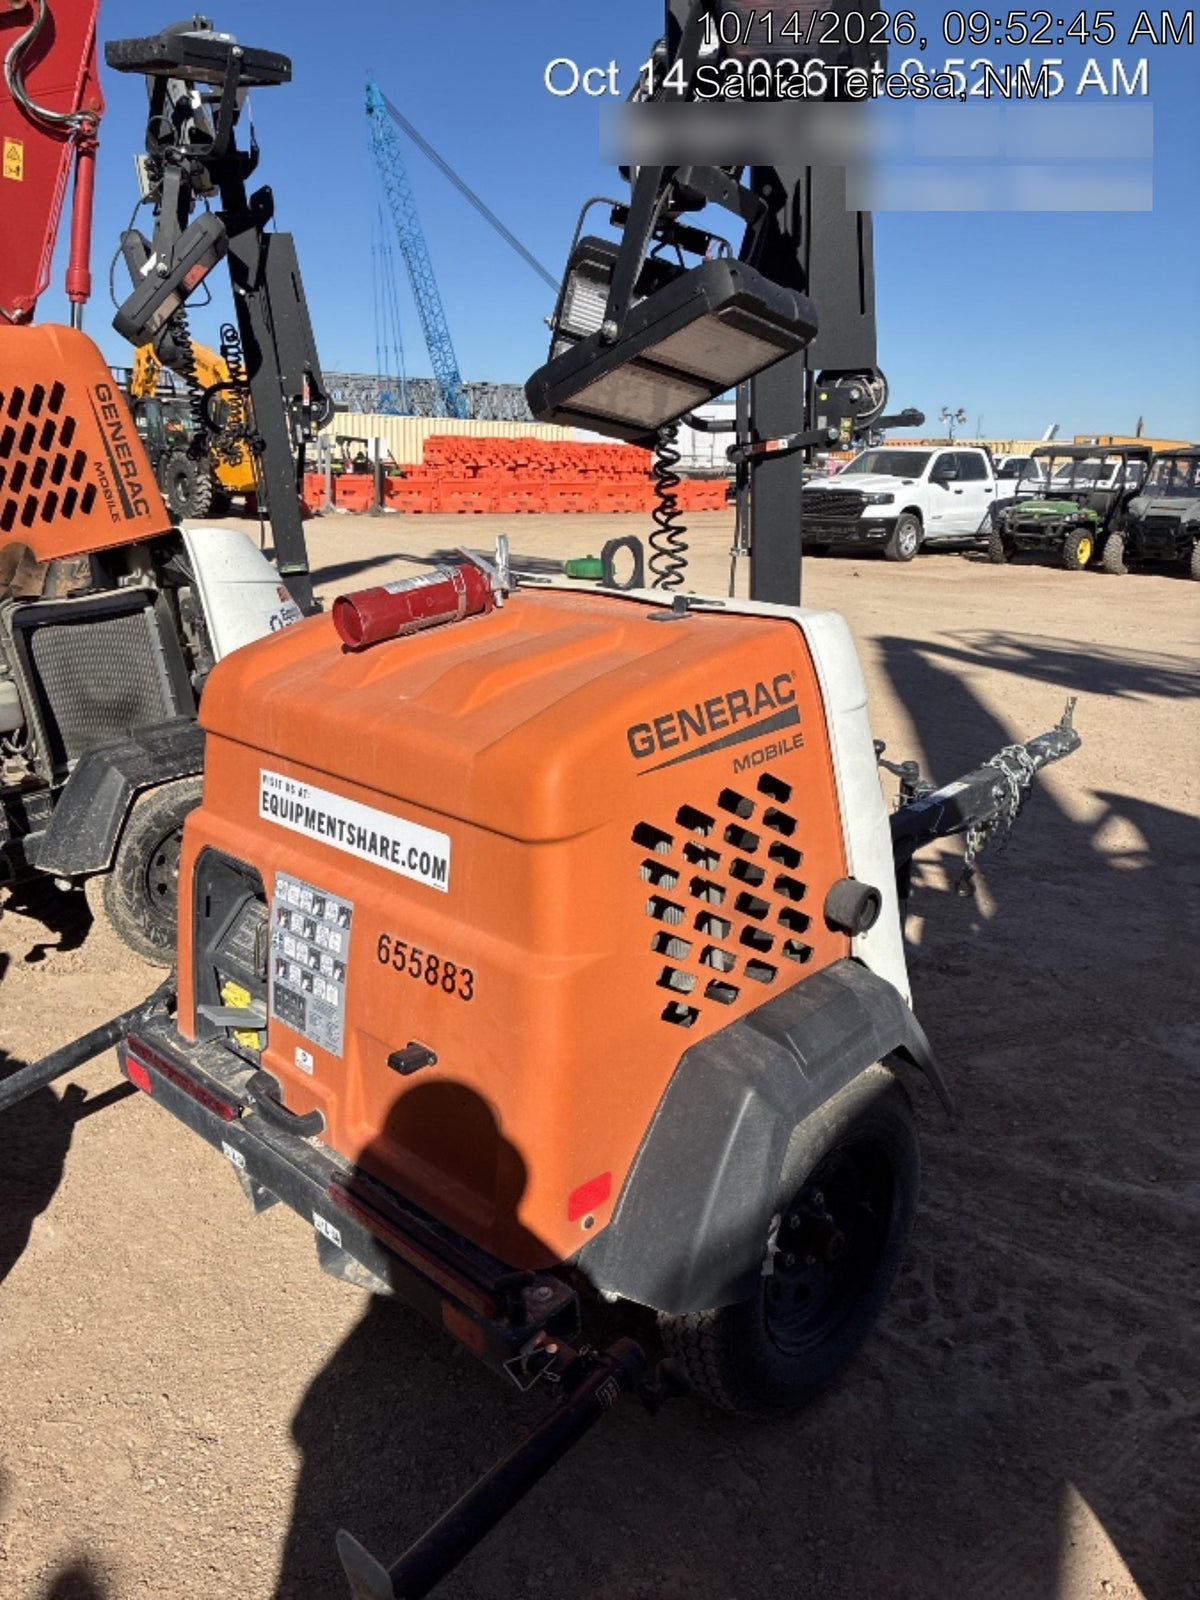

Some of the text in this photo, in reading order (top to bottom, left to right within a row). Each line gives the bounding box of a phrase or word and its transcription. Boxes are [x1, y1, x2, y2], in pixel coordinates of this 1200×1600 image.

[94, 383, 150, 516] GENERAC
[94, 461, 121, 523] MOBILE
[627, 673, 796, 759] GENERAC
[733, 733, 804, 773] MOBILE
[262, 790, 447, 883] EQUIPMENTSHARE.COM
[377, 933, 474, 1001] 655883
